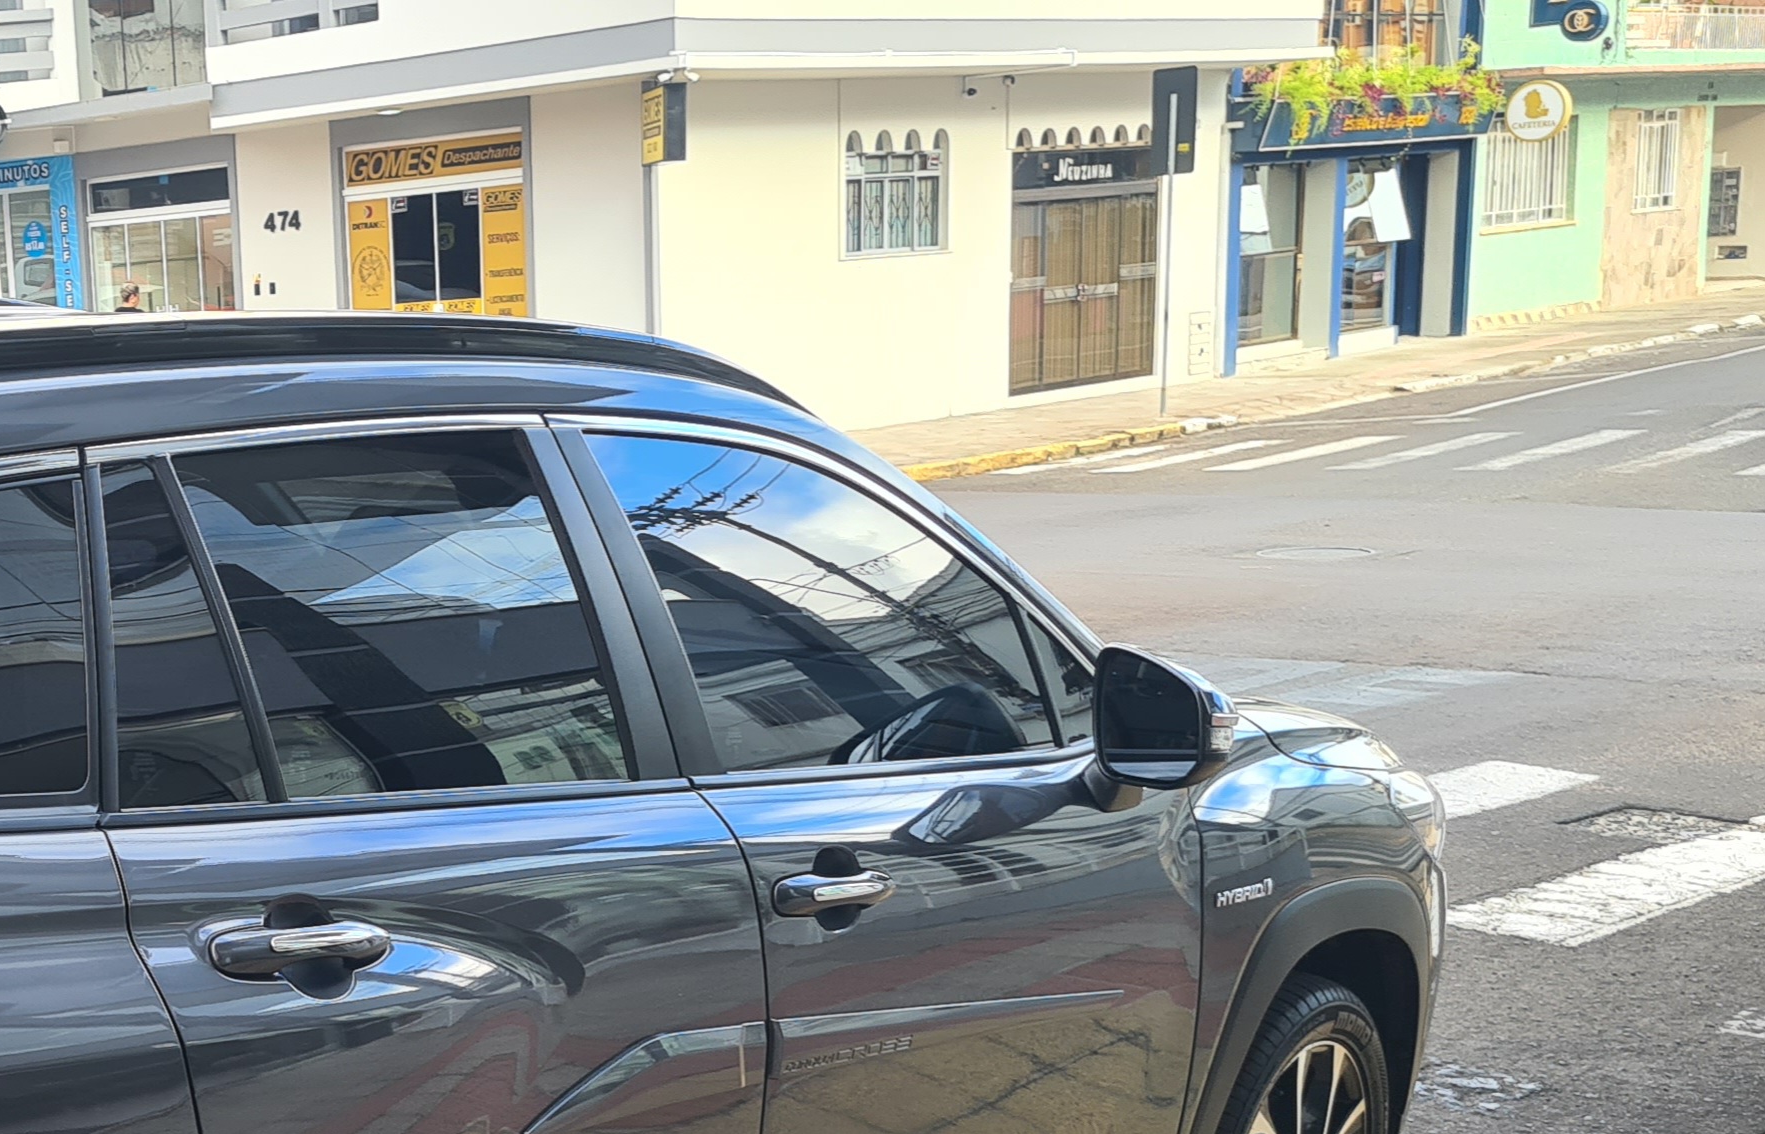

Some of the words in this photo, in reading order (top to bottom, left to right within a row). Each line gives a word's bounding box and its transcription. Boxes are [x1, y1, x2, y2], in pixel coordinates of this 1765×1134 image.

[1511, 120, 1557, 130] CAFETERIA
[349, 145, 438, 183] GOMES
[443, 143, 520, 165] Despachante
[264, 210, 302, 233] 474
[1216, 884, 1264, 908] HYBRID
[835, 1033, 914, 1064] CROSS
